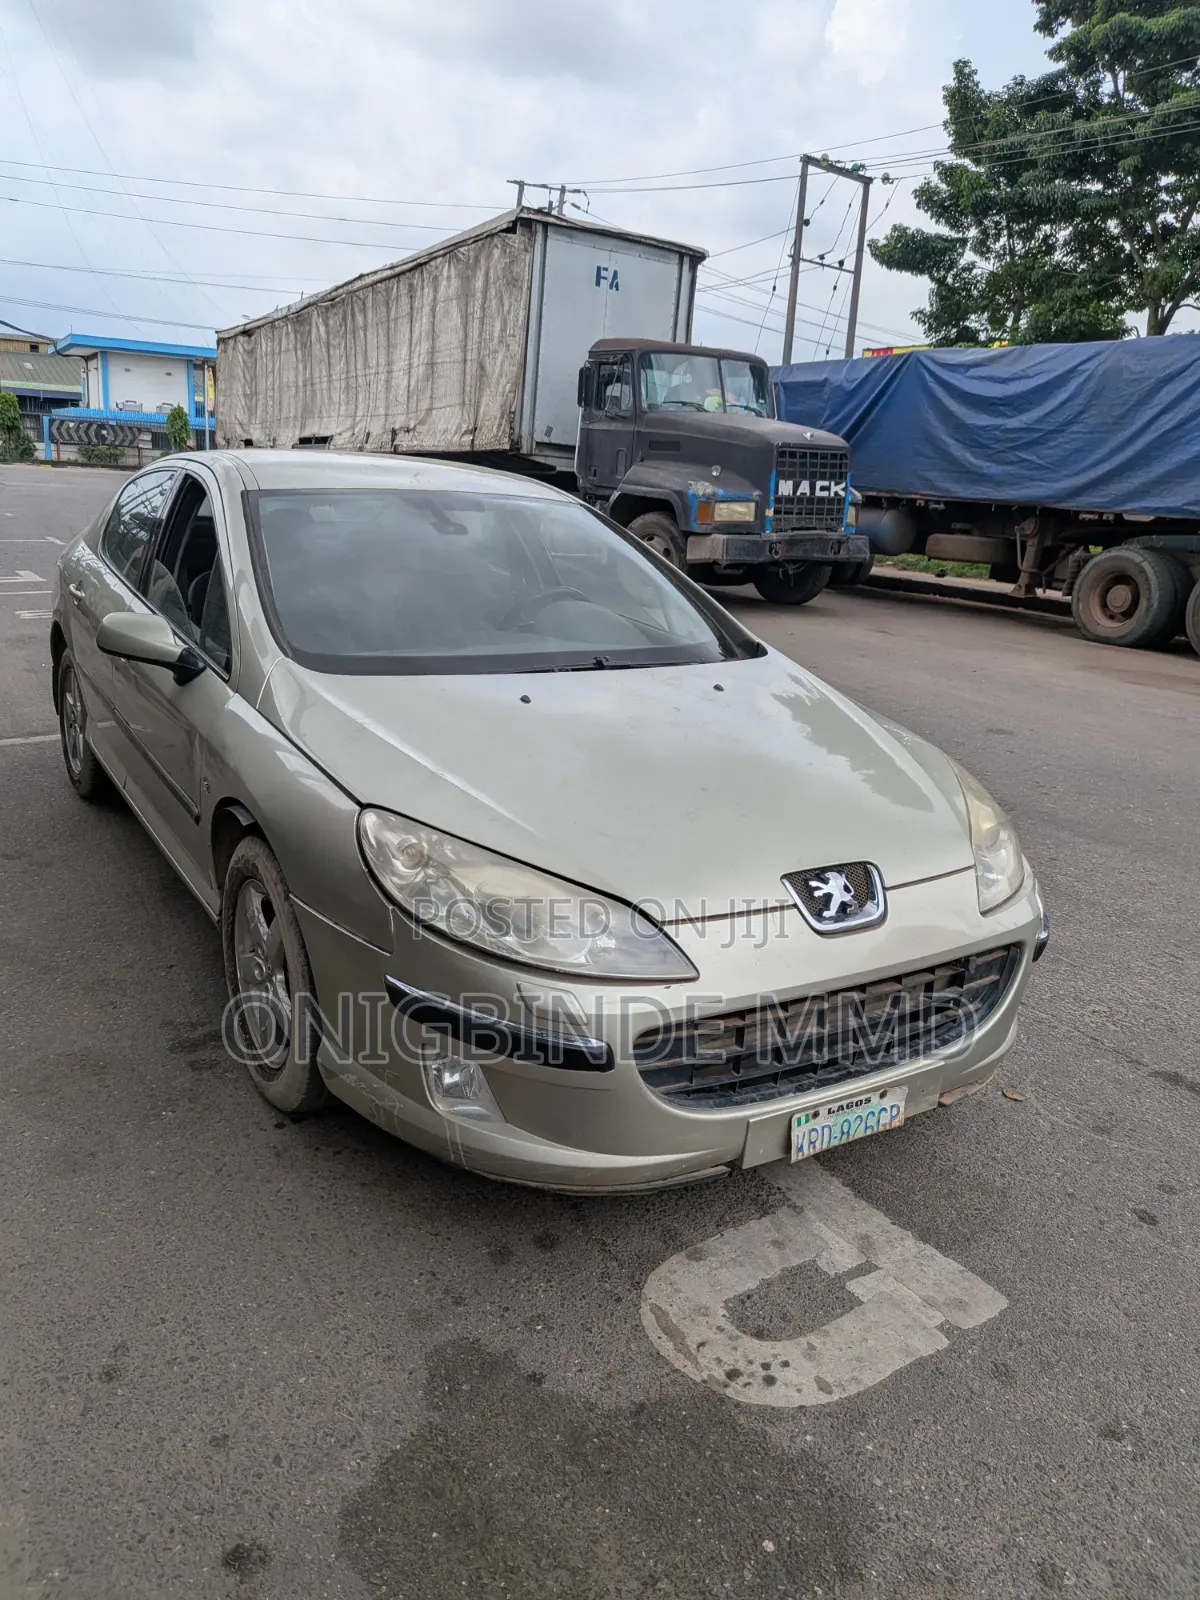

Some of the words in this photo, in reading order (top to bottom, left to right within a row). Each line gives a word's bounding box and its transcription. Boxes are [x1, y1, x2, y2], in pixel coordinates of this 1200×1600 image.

[595, 265, 619, 291] FA
[778, 479, 846, 497] MACK
[827, 1097, 872, 1115] LAGOS
